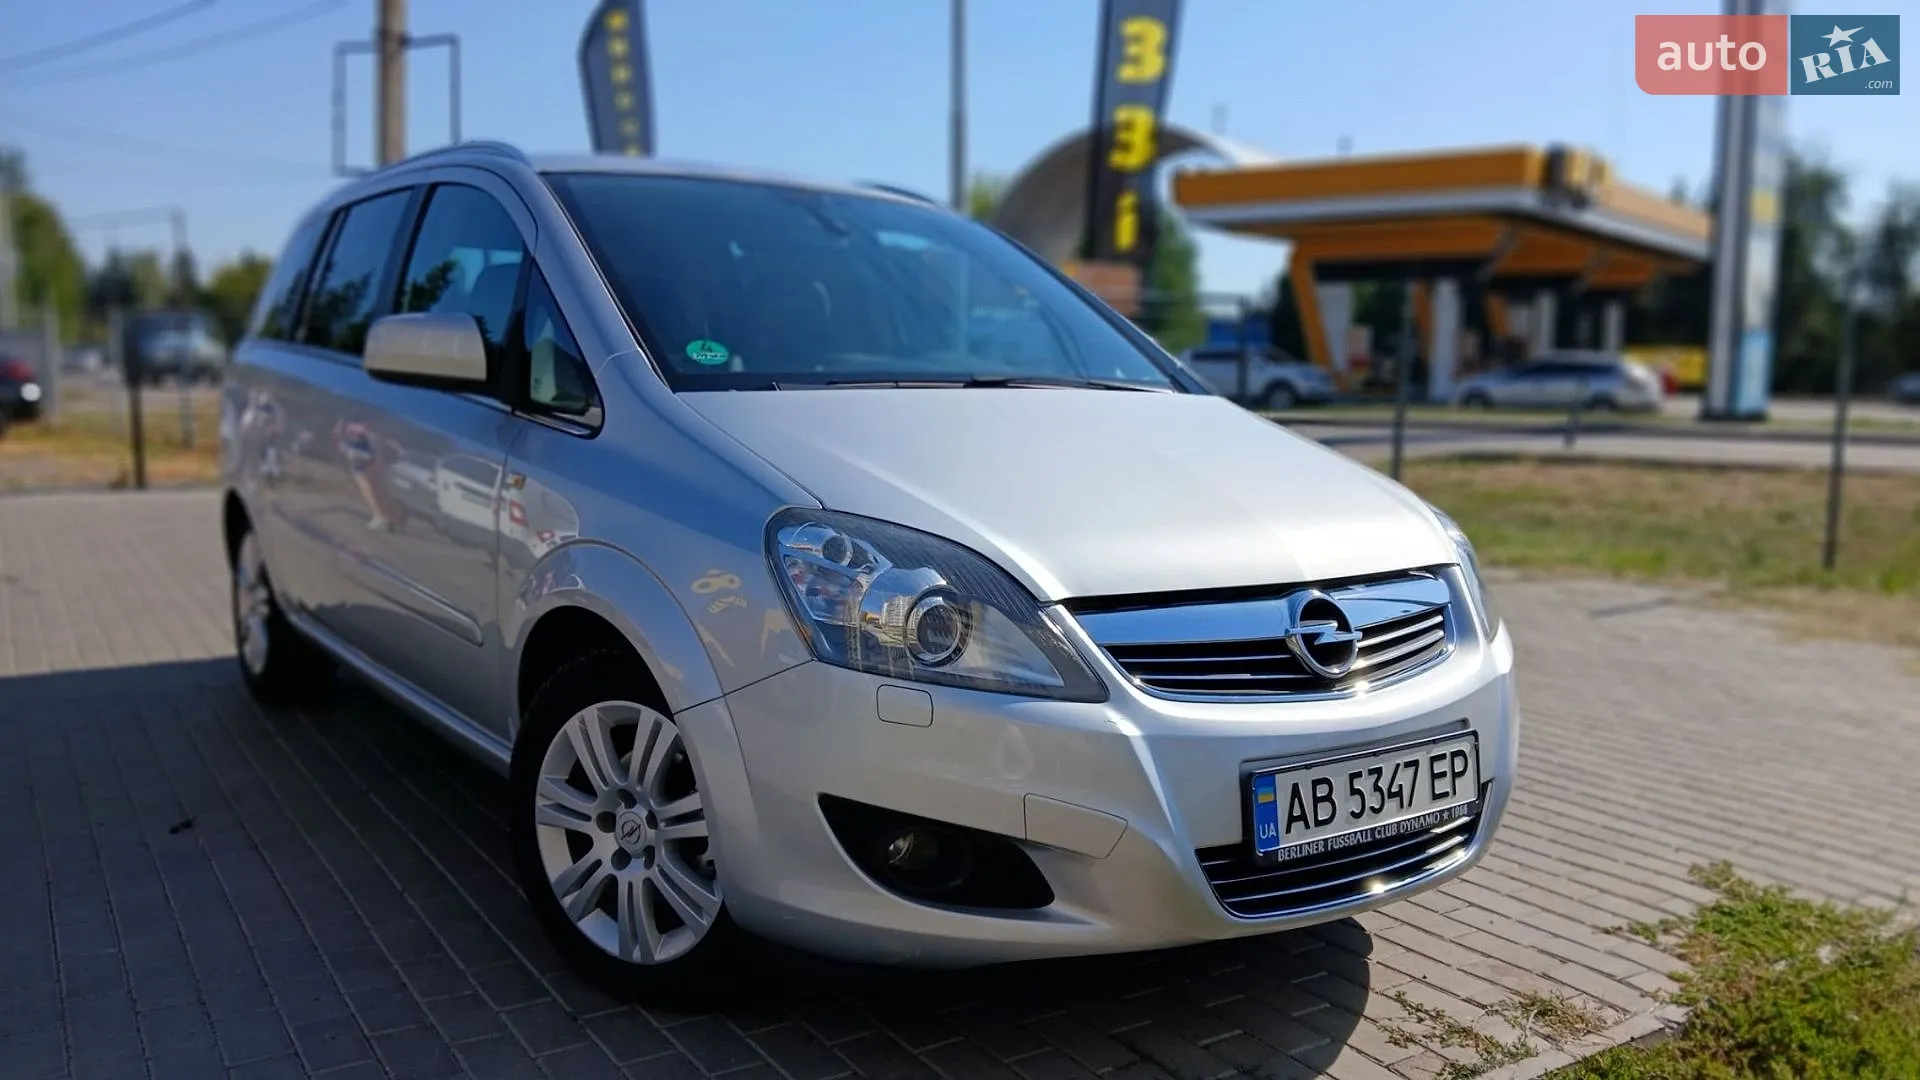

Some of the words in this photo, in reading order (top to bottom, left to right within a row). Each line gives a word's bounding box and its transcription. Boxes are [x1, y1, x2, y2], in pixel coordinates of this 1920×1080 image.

[1285, 777, 1337, 834] AB
[1348, 759, 1420, 819] 5347
[1429, 749, 1469, 800] EP
[1259, 822, 1276, 839] UA
[1277, 839, 1325, 862] BERLINER
[1327, 828, 1373, 851] FUSSBALL
[1374, 822, 1398, 840] CLUB
[1400, 812, 1441, 833] DYNAMO
